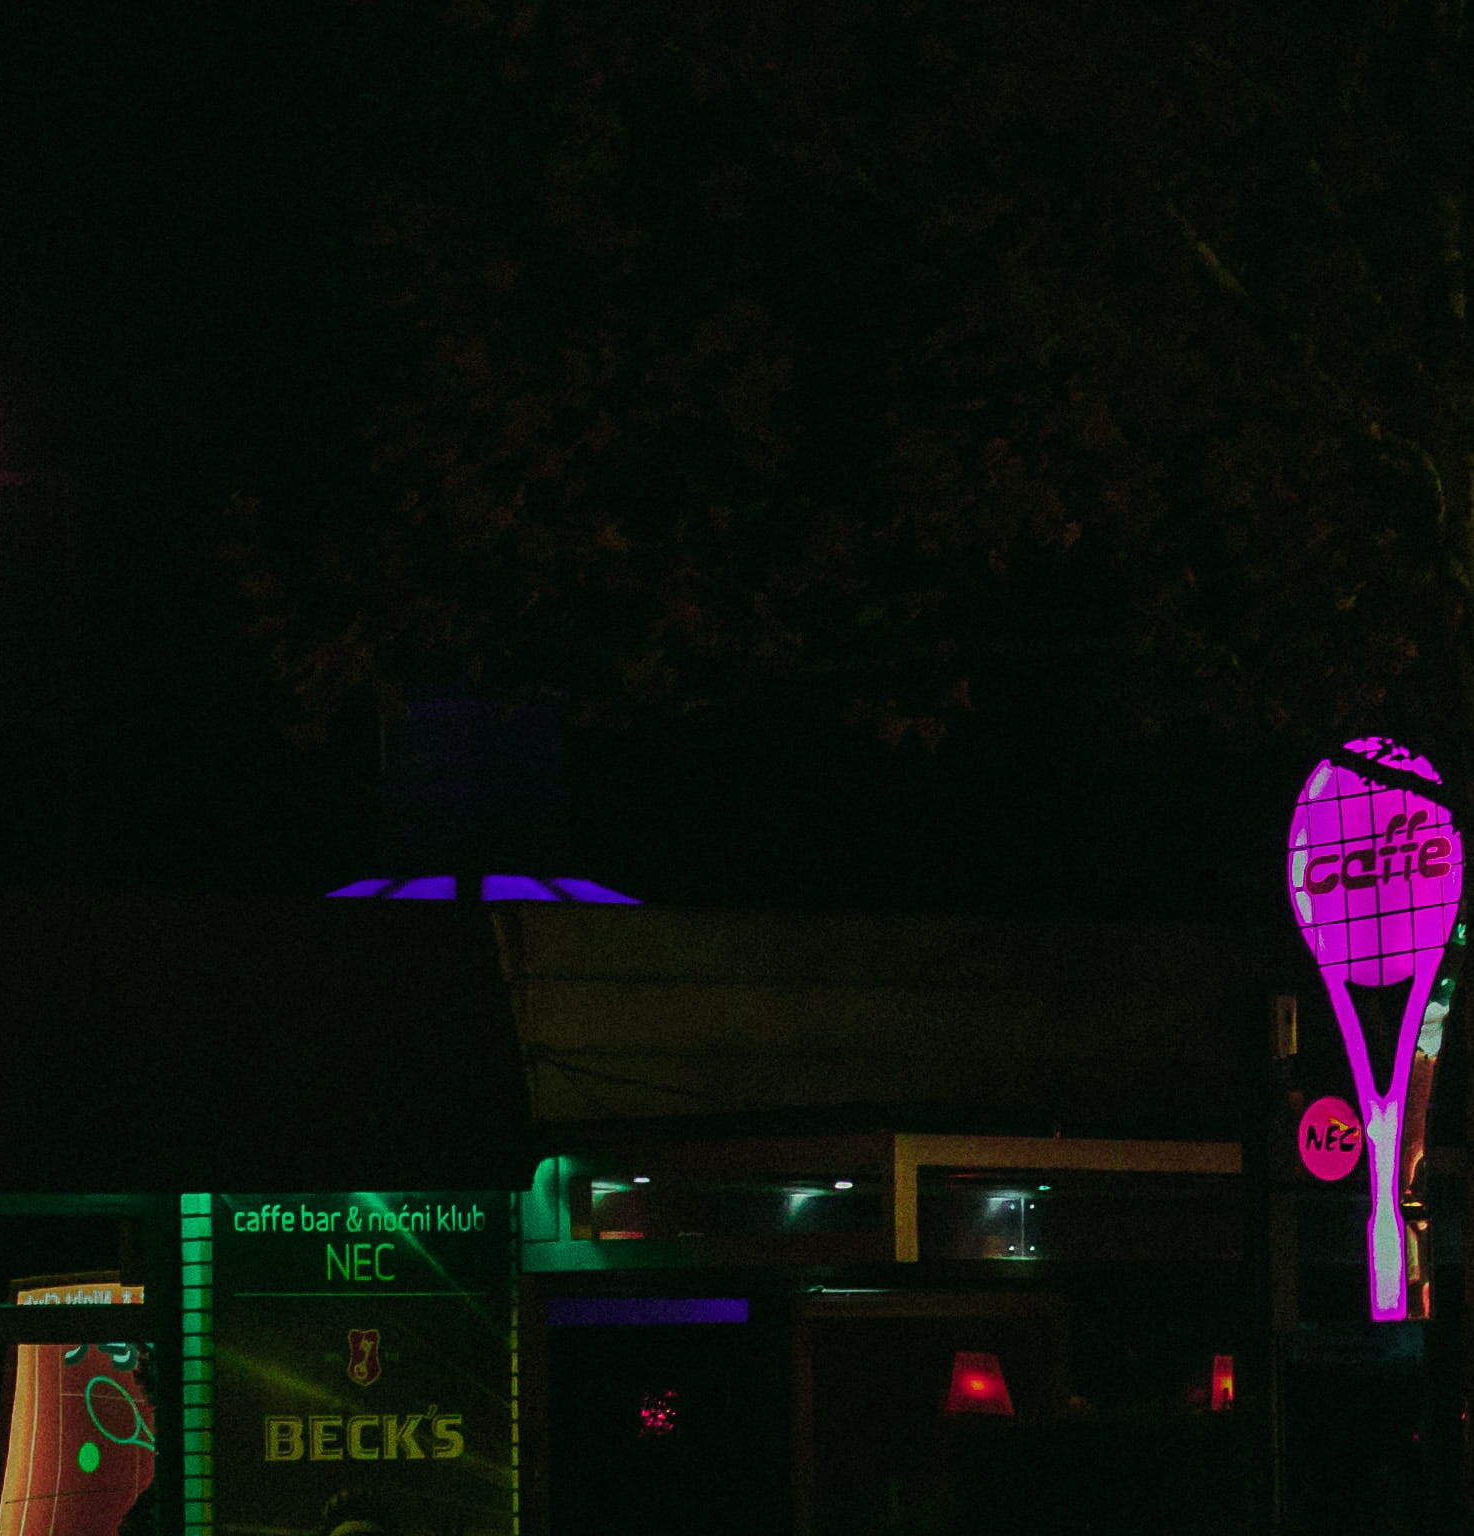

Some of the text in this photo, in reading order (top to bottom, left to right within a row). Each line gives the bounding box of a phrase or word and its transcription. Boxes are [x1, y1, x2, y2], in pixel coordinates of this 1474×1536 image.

[1305, 809, 1452, 895] caffe
[1306, 1125, 1358, 1152] NEC
[233, 1204, 295, 1232] caffe
[301, 1204, 341, 1232] bar
[345, 1206, 363, 1233] &
[436, 1205, 486, 1232] klub
[325, 1242, 396, 1282] NEC
